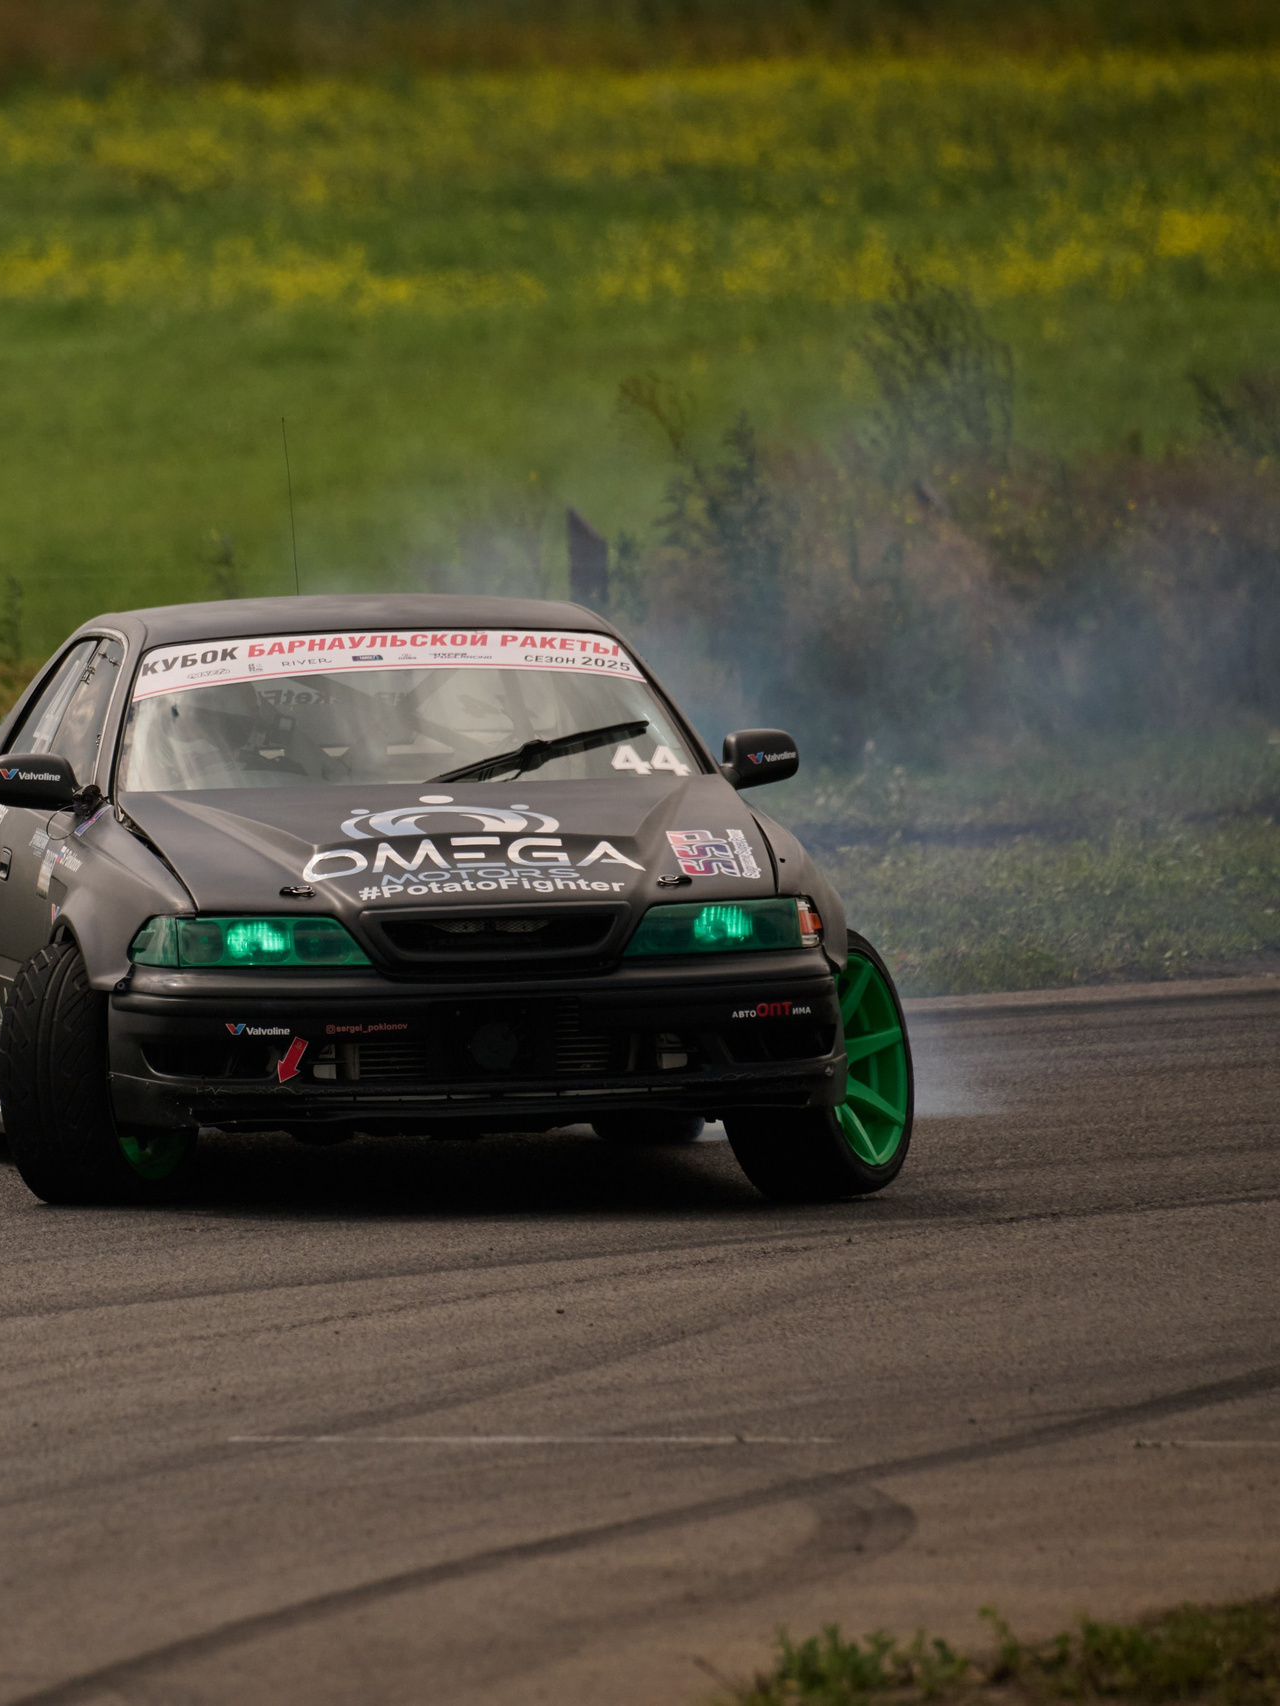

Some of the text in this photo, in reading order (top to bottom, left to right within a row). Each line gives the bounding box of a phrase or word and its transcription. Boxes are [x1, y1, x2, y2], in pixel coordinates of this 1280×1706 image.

[141, 631, 620, 676] КУБОК БАРНАУЛЬСКОЙ РАКЕТЫ
[281, 657, 332, 667] RIVER
[524, 654, 631, 672] СЕЗОН 2025
[611, 745, 691, 776] 44
[765, 751, 797, 763] Valvoline
[18, 771, 60, 782] Valvoline
[303, 836, 646, 883] OMEGA
[380, 868, 580, 886] MOTORS
[358, 876, 625, 901] #PotatoFighter
[246, 1026, 291, 1036] Valvoline
[336, 1022, 408, 1034] sergei_poklonov
